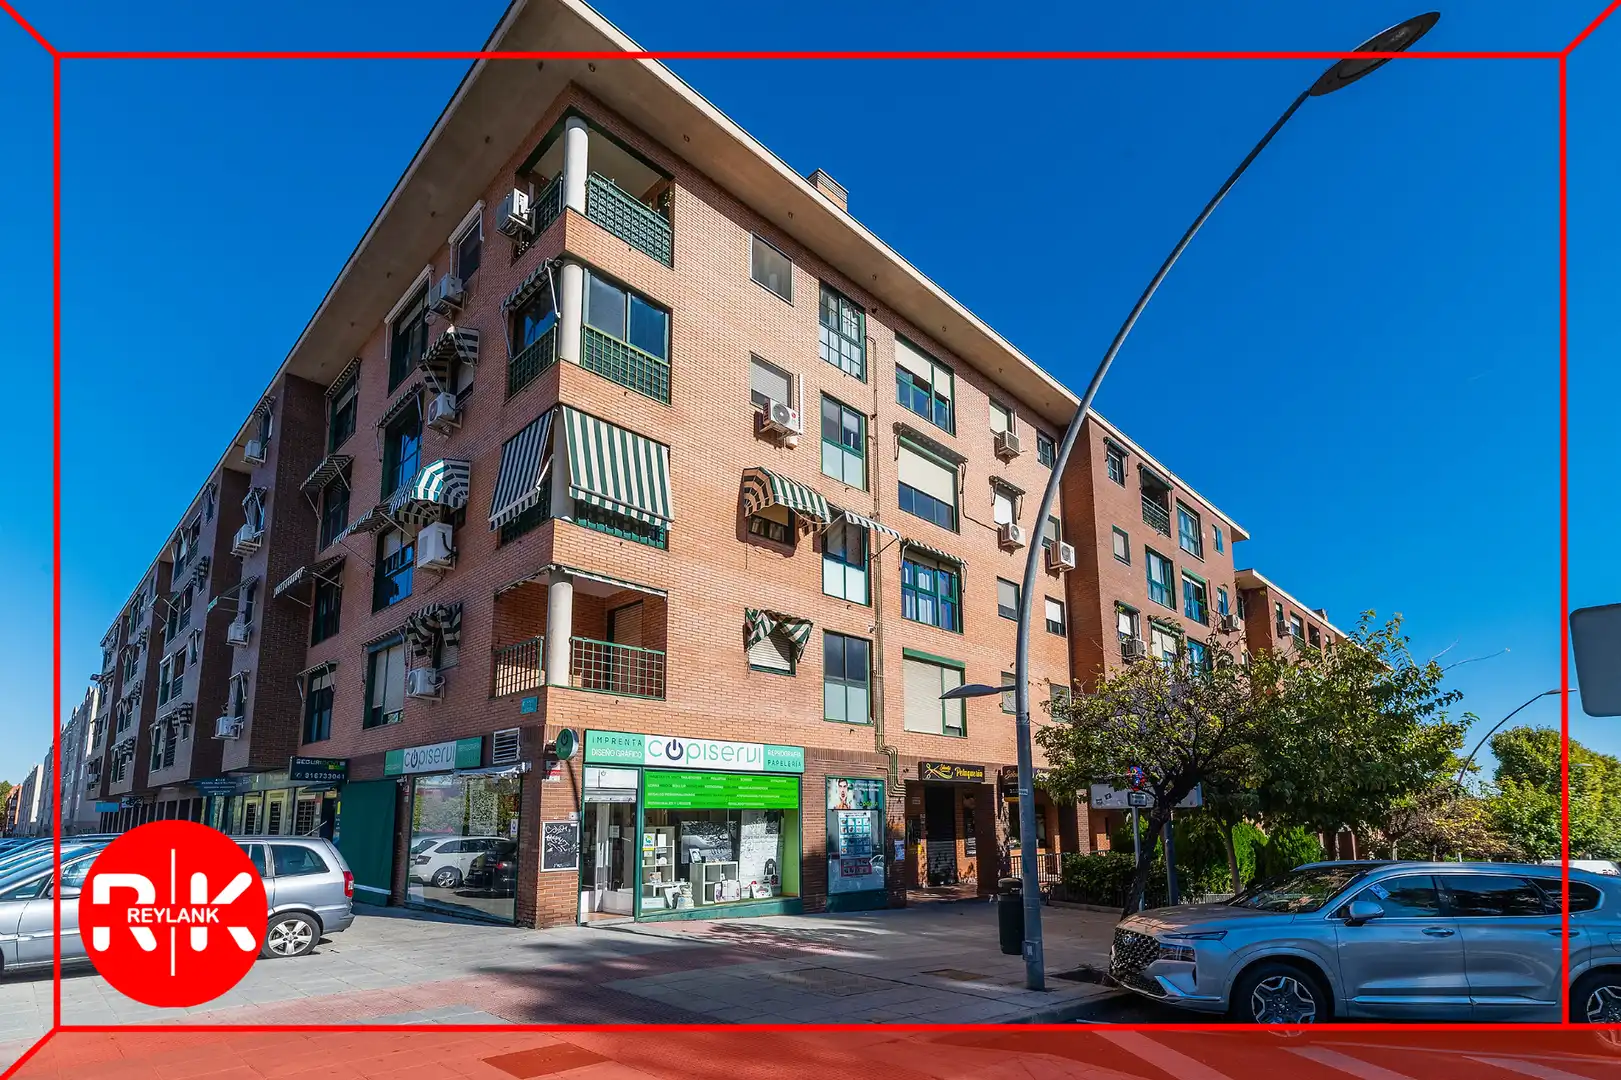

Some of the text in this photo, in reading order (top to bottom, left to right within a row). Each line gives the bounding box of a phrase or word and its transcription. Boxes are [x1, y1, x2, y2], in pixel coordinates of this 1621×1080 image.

[592, 736, 643, 747] IMPRENTA
[591, 747, 616, 757] DISEÑO
[767, 759, 802, 768] PAPELERÍA
